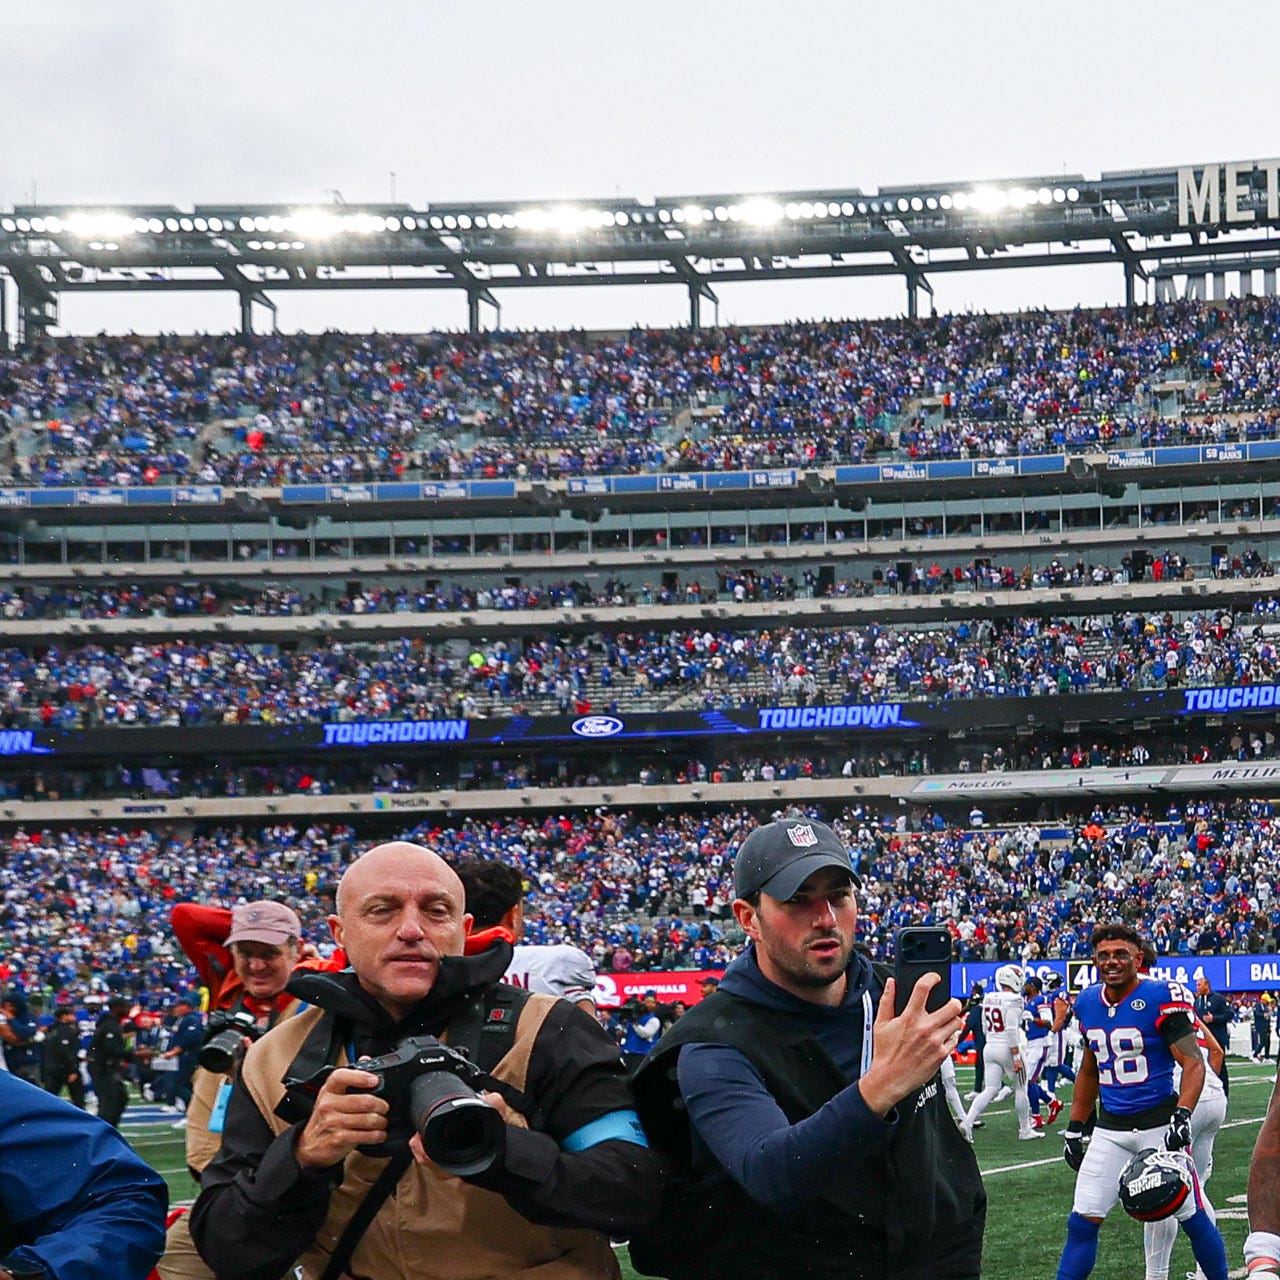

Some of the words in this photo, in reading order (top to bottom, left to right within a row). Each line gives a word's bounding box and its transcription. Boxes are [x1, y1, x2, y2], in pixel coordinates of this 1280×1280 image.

[581, 719, 614, 734] Ford
[758, 704, 901, 729] TOUCHDOWN
[323, 720, 468, 744] TOUCHDOWN
[948, 780, 1013, 789] MetLife
[623, 984, 687, 995] CARDINALS
[984, 1007, 1005, 1033] 59
[1085, 1026, 1149, 1086] 28
[1128, 1171, 1162, 1197] GIANTS
